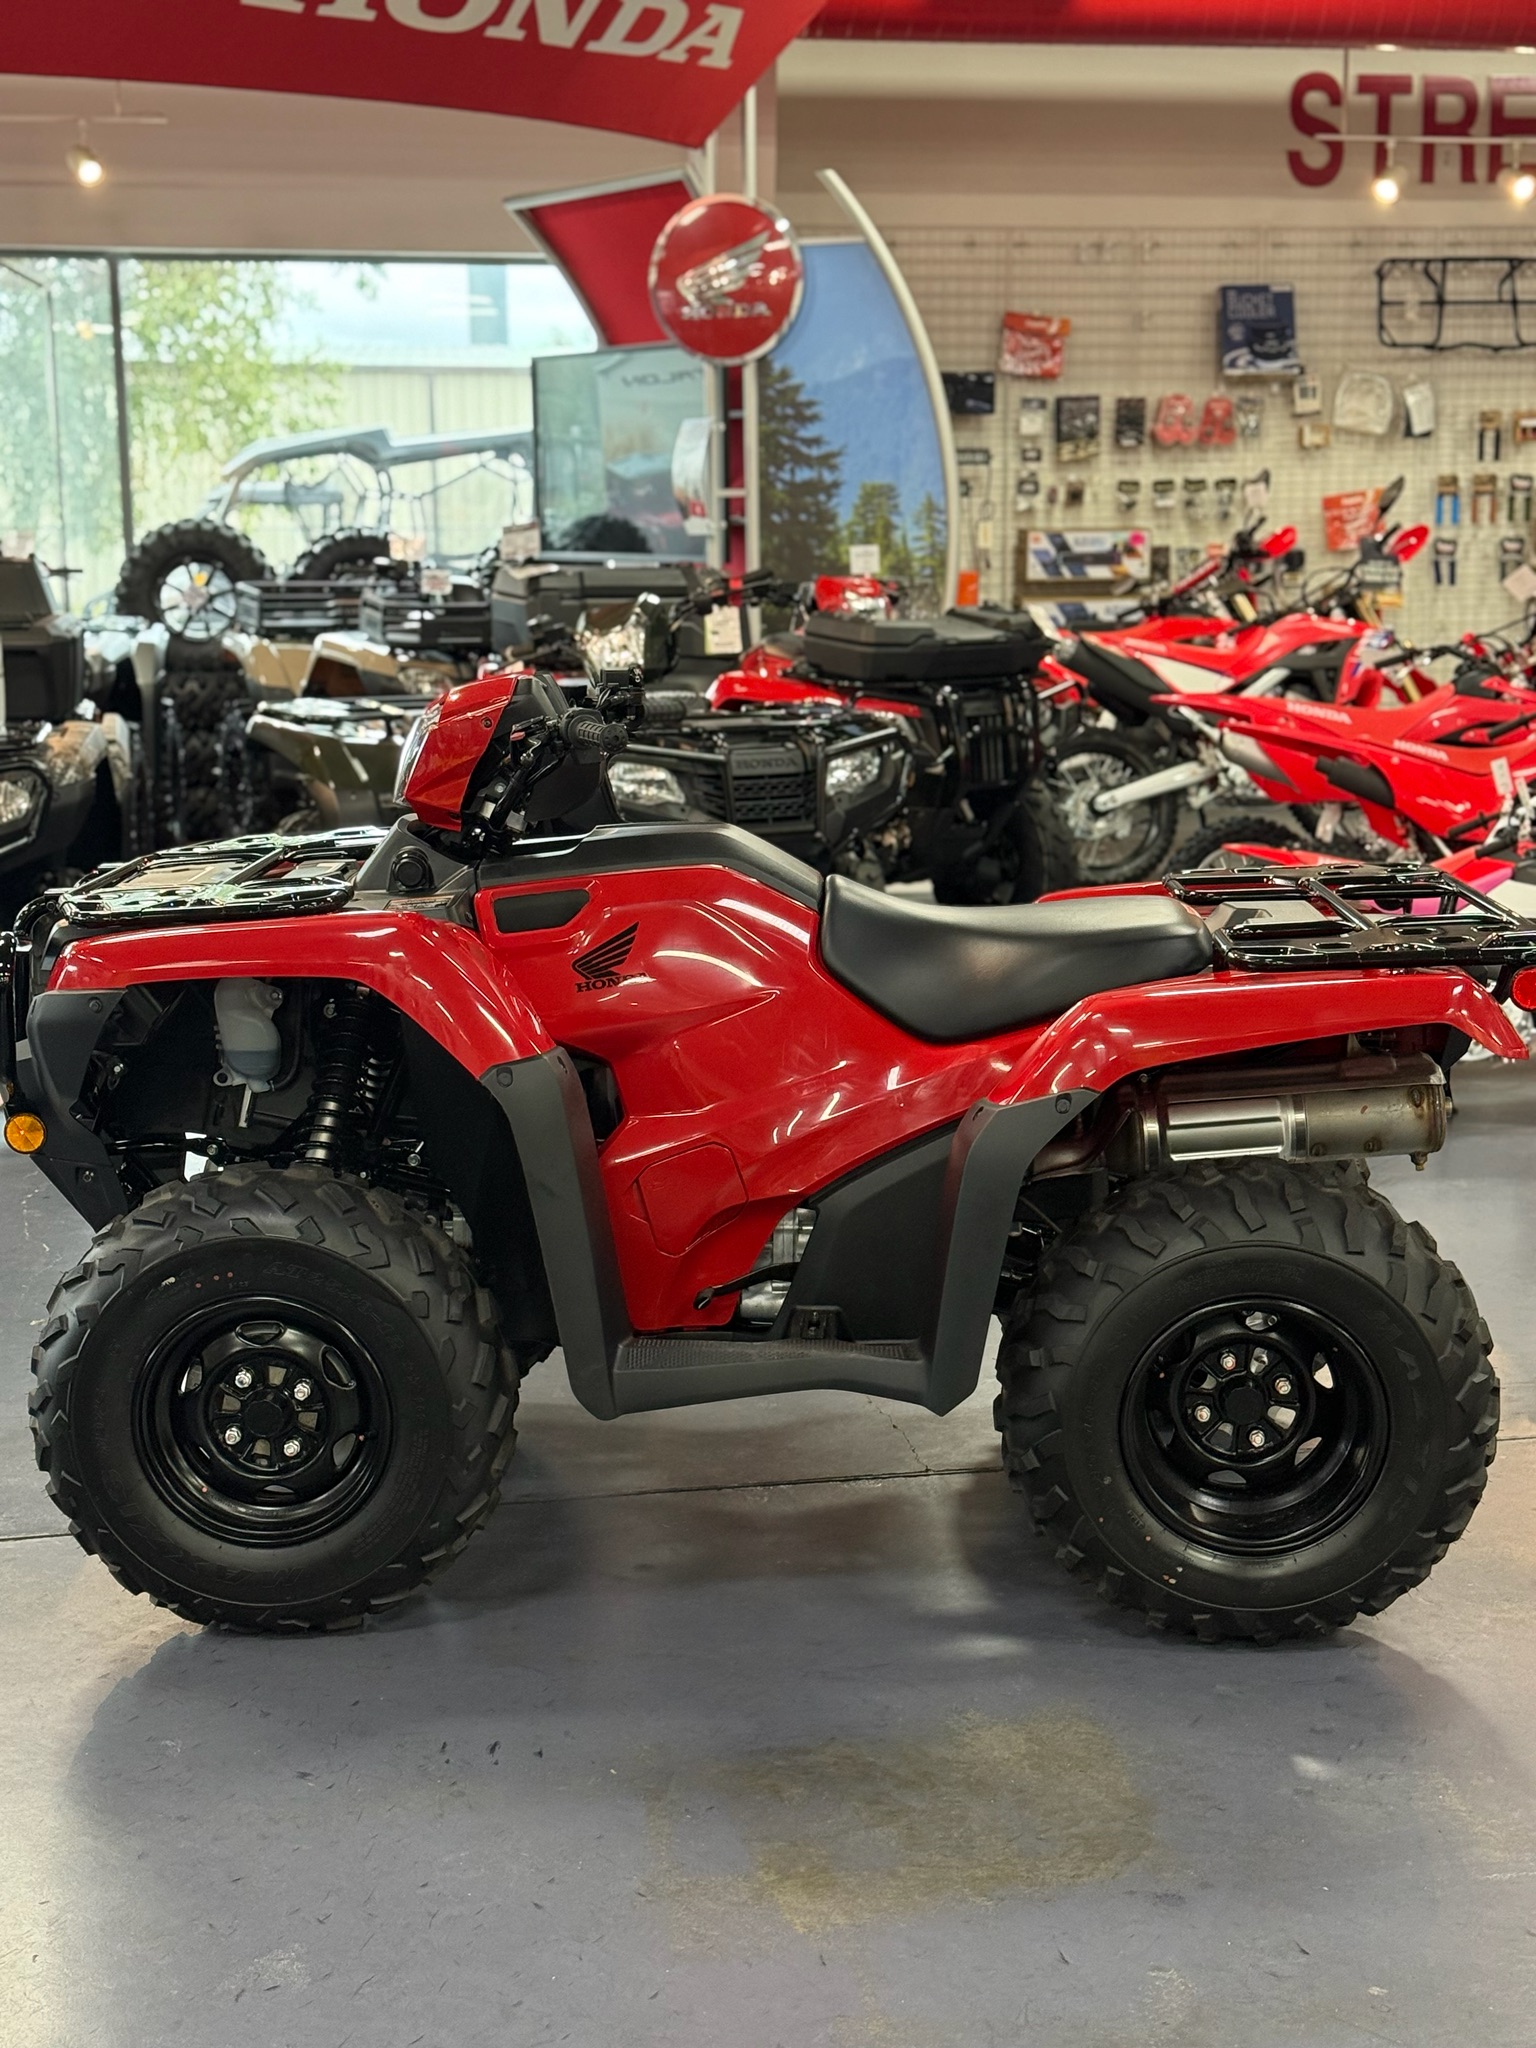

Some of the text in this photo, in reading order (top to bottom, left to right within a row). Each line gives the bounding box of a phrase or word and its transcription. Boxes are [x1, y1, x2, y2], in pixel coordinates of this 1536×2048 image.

[240, 0, 743, 70] ONDA
[1286, 701, 1353, 725] HONDA
[1393, 738, 1449, 763] HONDA
[735, 757, 798, 770] HONDA
